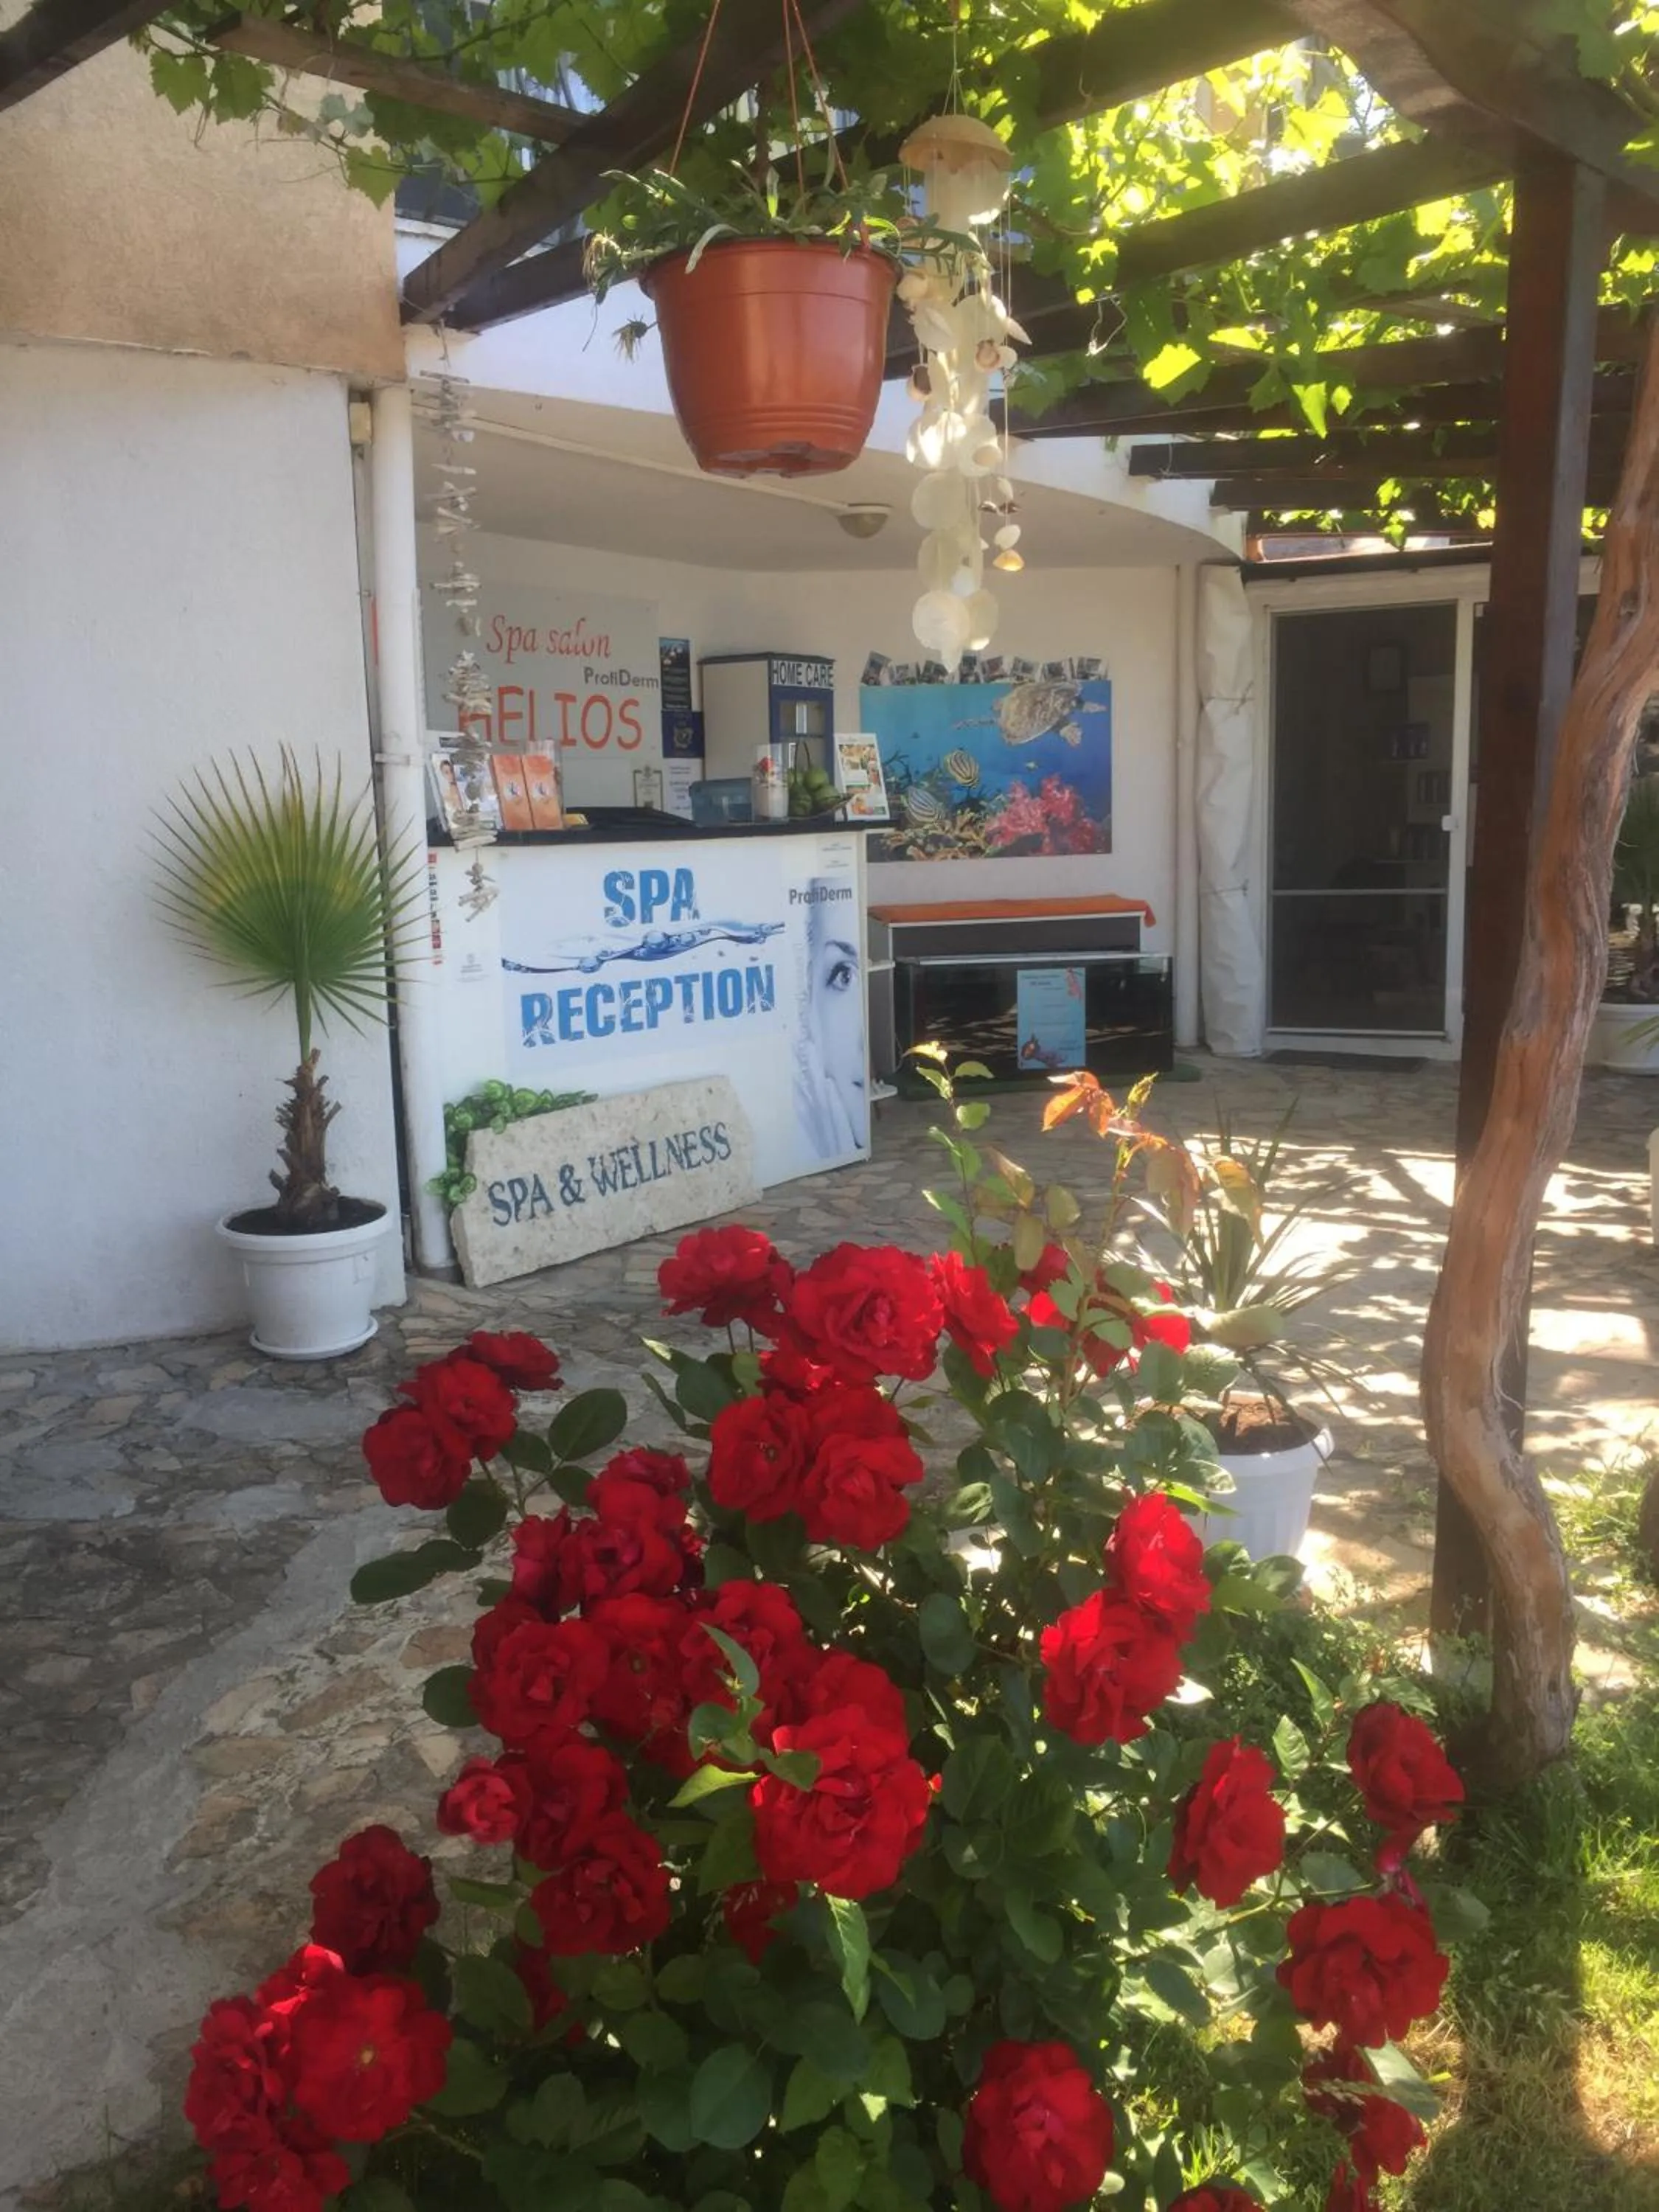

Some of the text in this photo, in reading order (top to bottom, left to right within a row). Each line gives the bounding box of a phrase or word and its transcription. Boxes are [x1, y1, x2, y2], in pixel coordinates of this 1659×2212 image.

[487, 614, 611, 664] Spa salon
[583, 666, 659, 689] ProfiDerm
[773, 661, 834, 687] HOME CARE
[603, 867, 700, 928] SPA
[520, 964, 776, 1048] RECEPTION
[487, 1121, 732, 1227] SPA & WELLNESS
